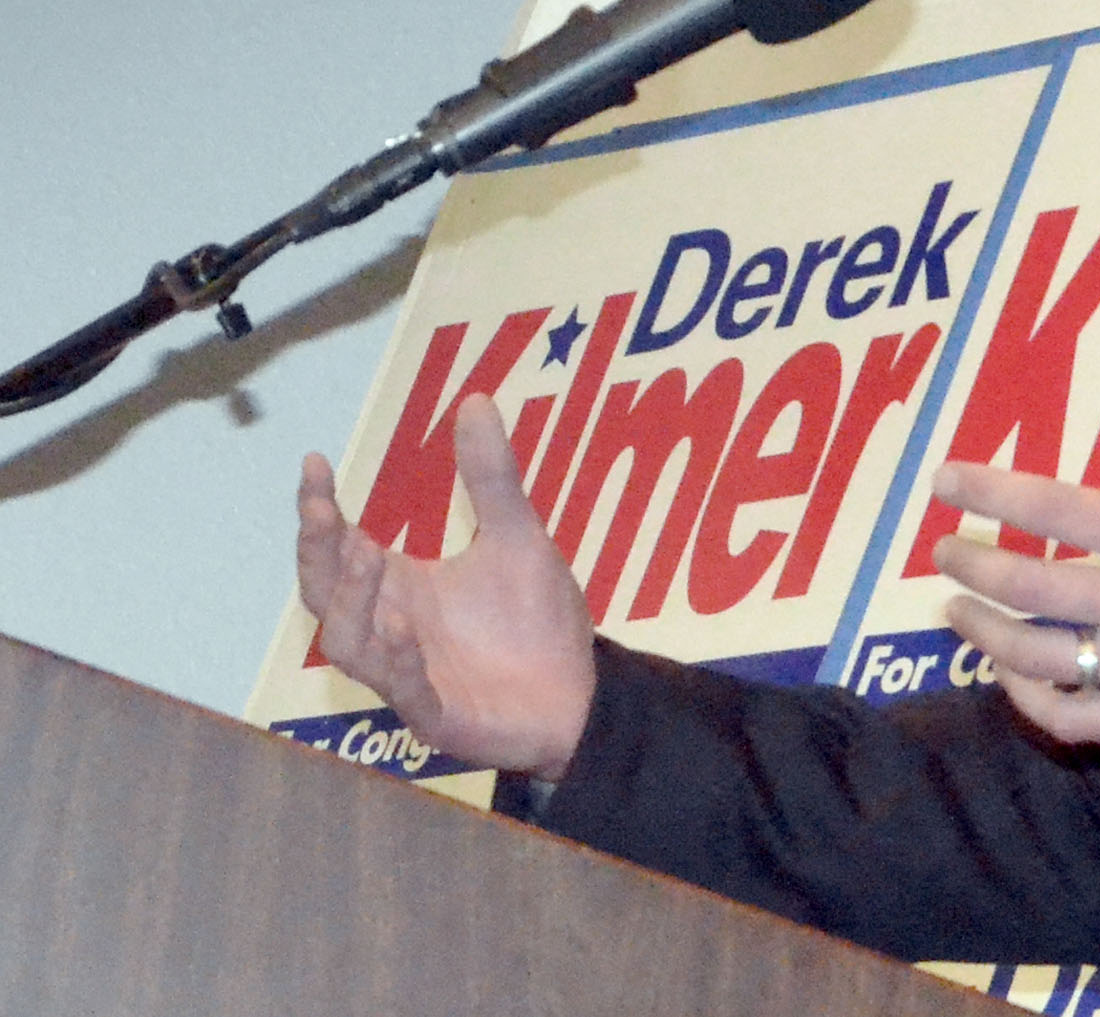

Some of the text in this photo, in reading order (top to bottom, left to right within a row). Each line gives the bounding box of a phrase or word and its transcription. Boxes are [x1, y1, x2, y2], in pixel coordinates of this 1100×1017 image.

[624, 179, 981, 357] Derek
[855, 644, 939, 696] For
[338, 718, 441, 772] Cong
